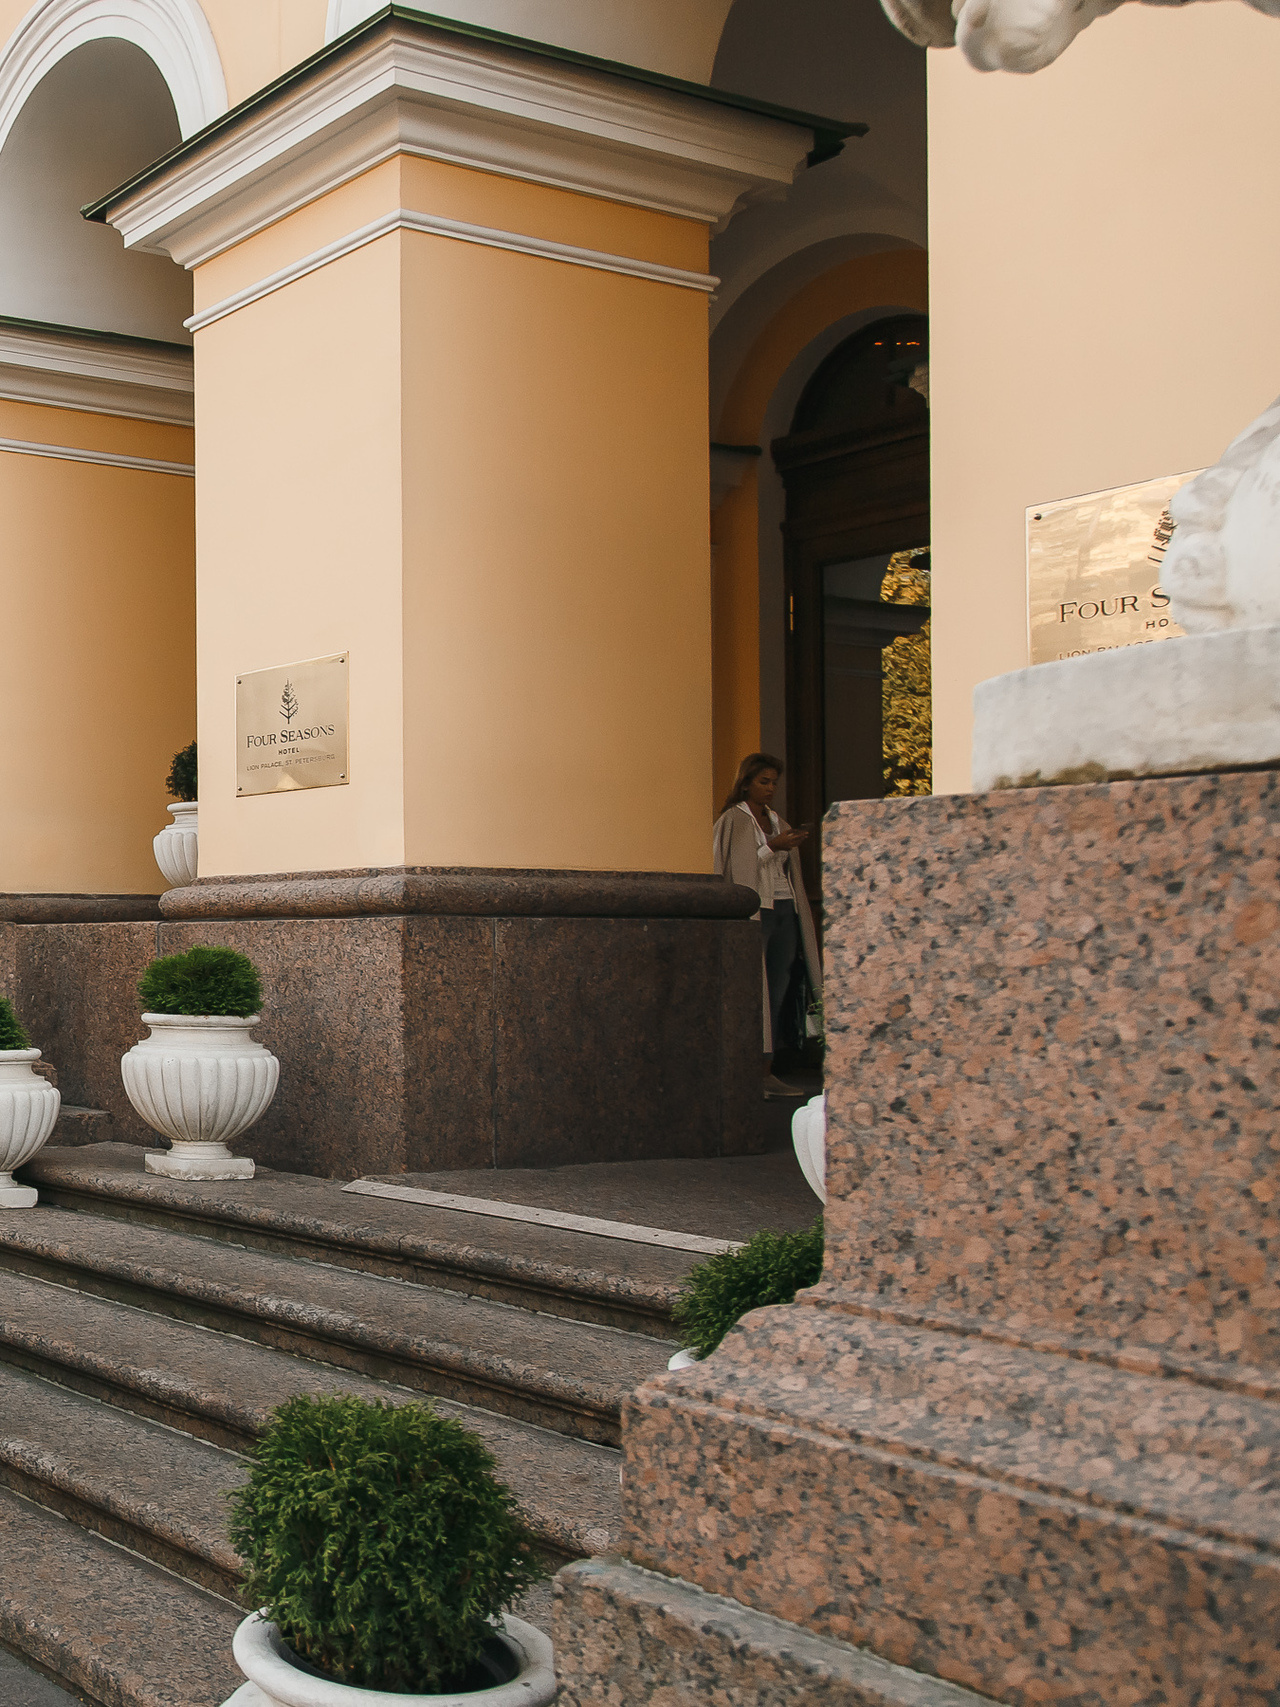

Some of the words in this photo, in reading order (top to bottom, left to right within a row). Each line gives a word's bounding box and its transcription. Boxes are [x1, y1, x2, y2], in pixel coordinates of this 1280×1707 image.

[1059, 595, 1139, 623] FOUR
[246, 734, 277, 748] FOUR
[280, 724, 335, 743] SEASONS
[278, 747, 300, 756] HOTEL
